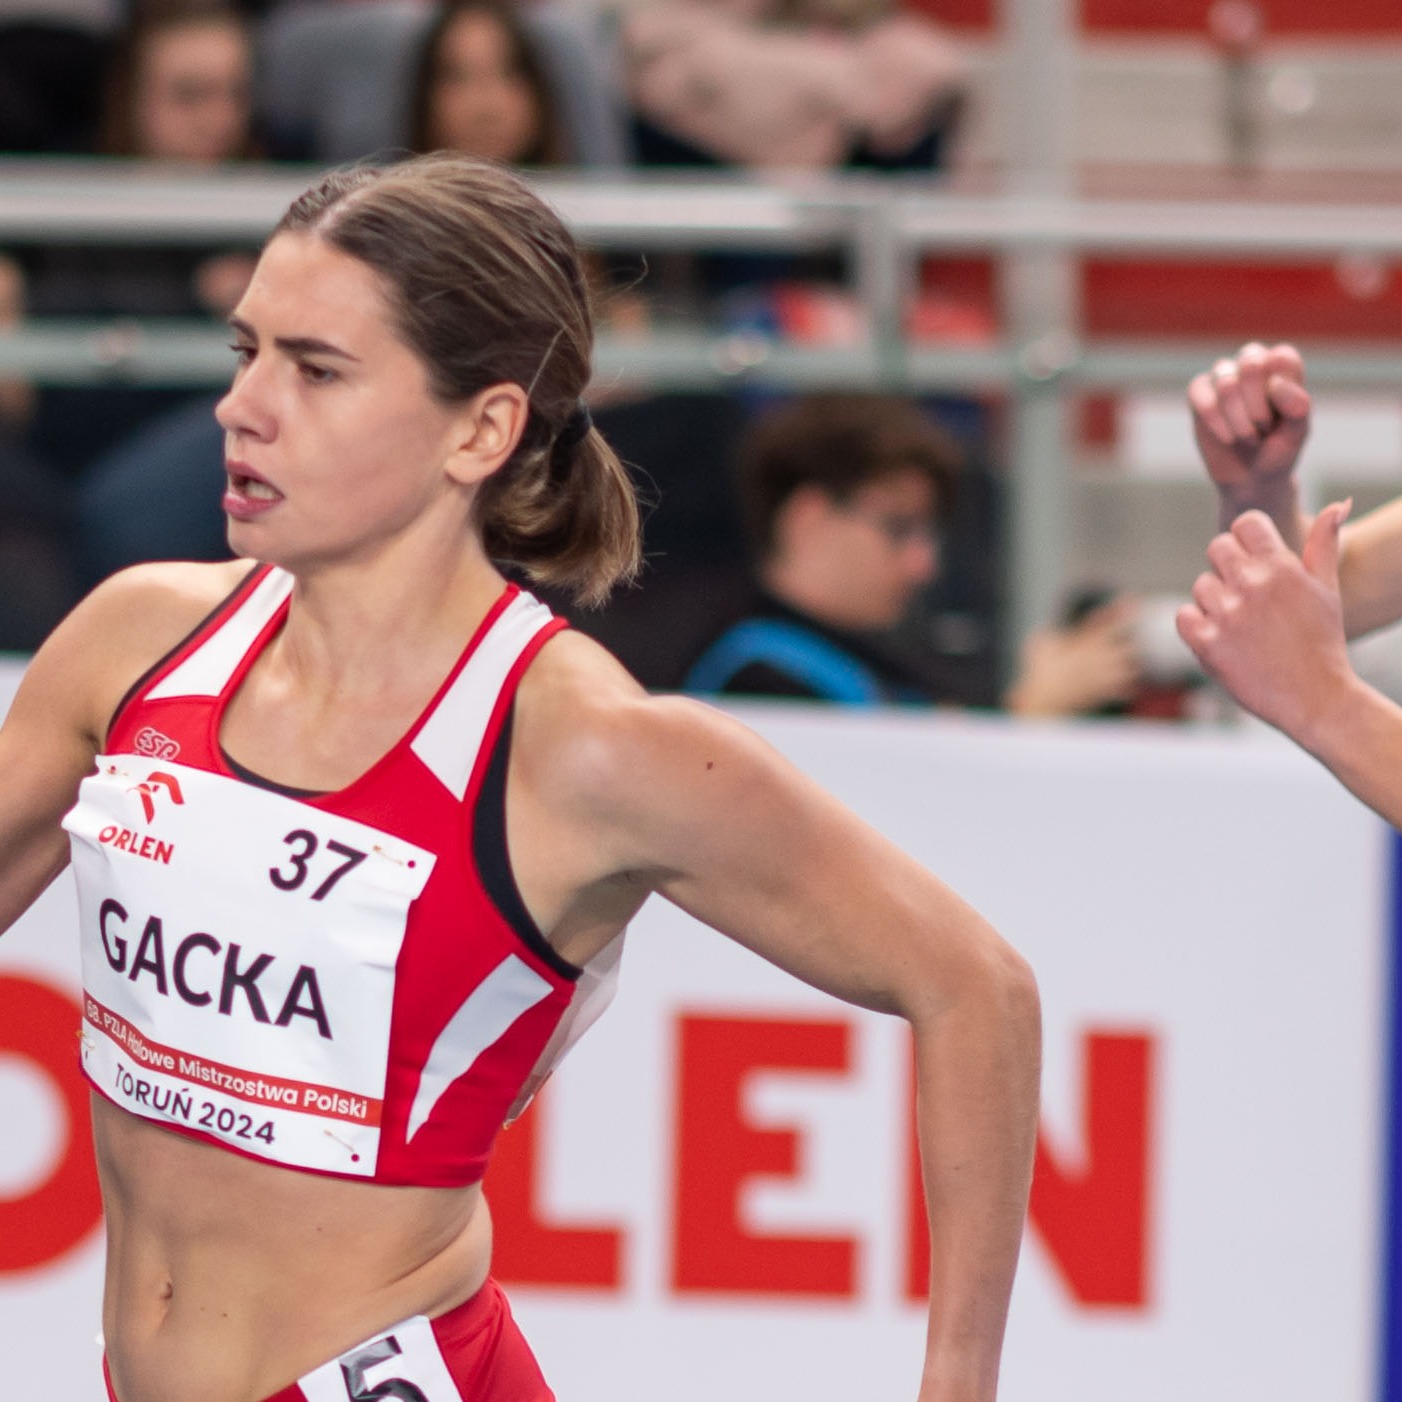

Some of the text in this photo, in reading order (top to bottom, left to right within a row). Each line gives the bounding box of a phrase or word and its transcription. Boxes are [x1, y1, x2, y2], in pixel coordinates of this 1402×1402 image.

[98, 825, 175, 865] ORLEN
[268, 828, 370, 902] 37
[98, 898, 334, 1041] GACKA
[115, 1062, 276, 1145] TORUŃ 2024
[178, 1056, 299, 1106] Mistrzostwa
[302, 1088, 368, 1119] Polski
